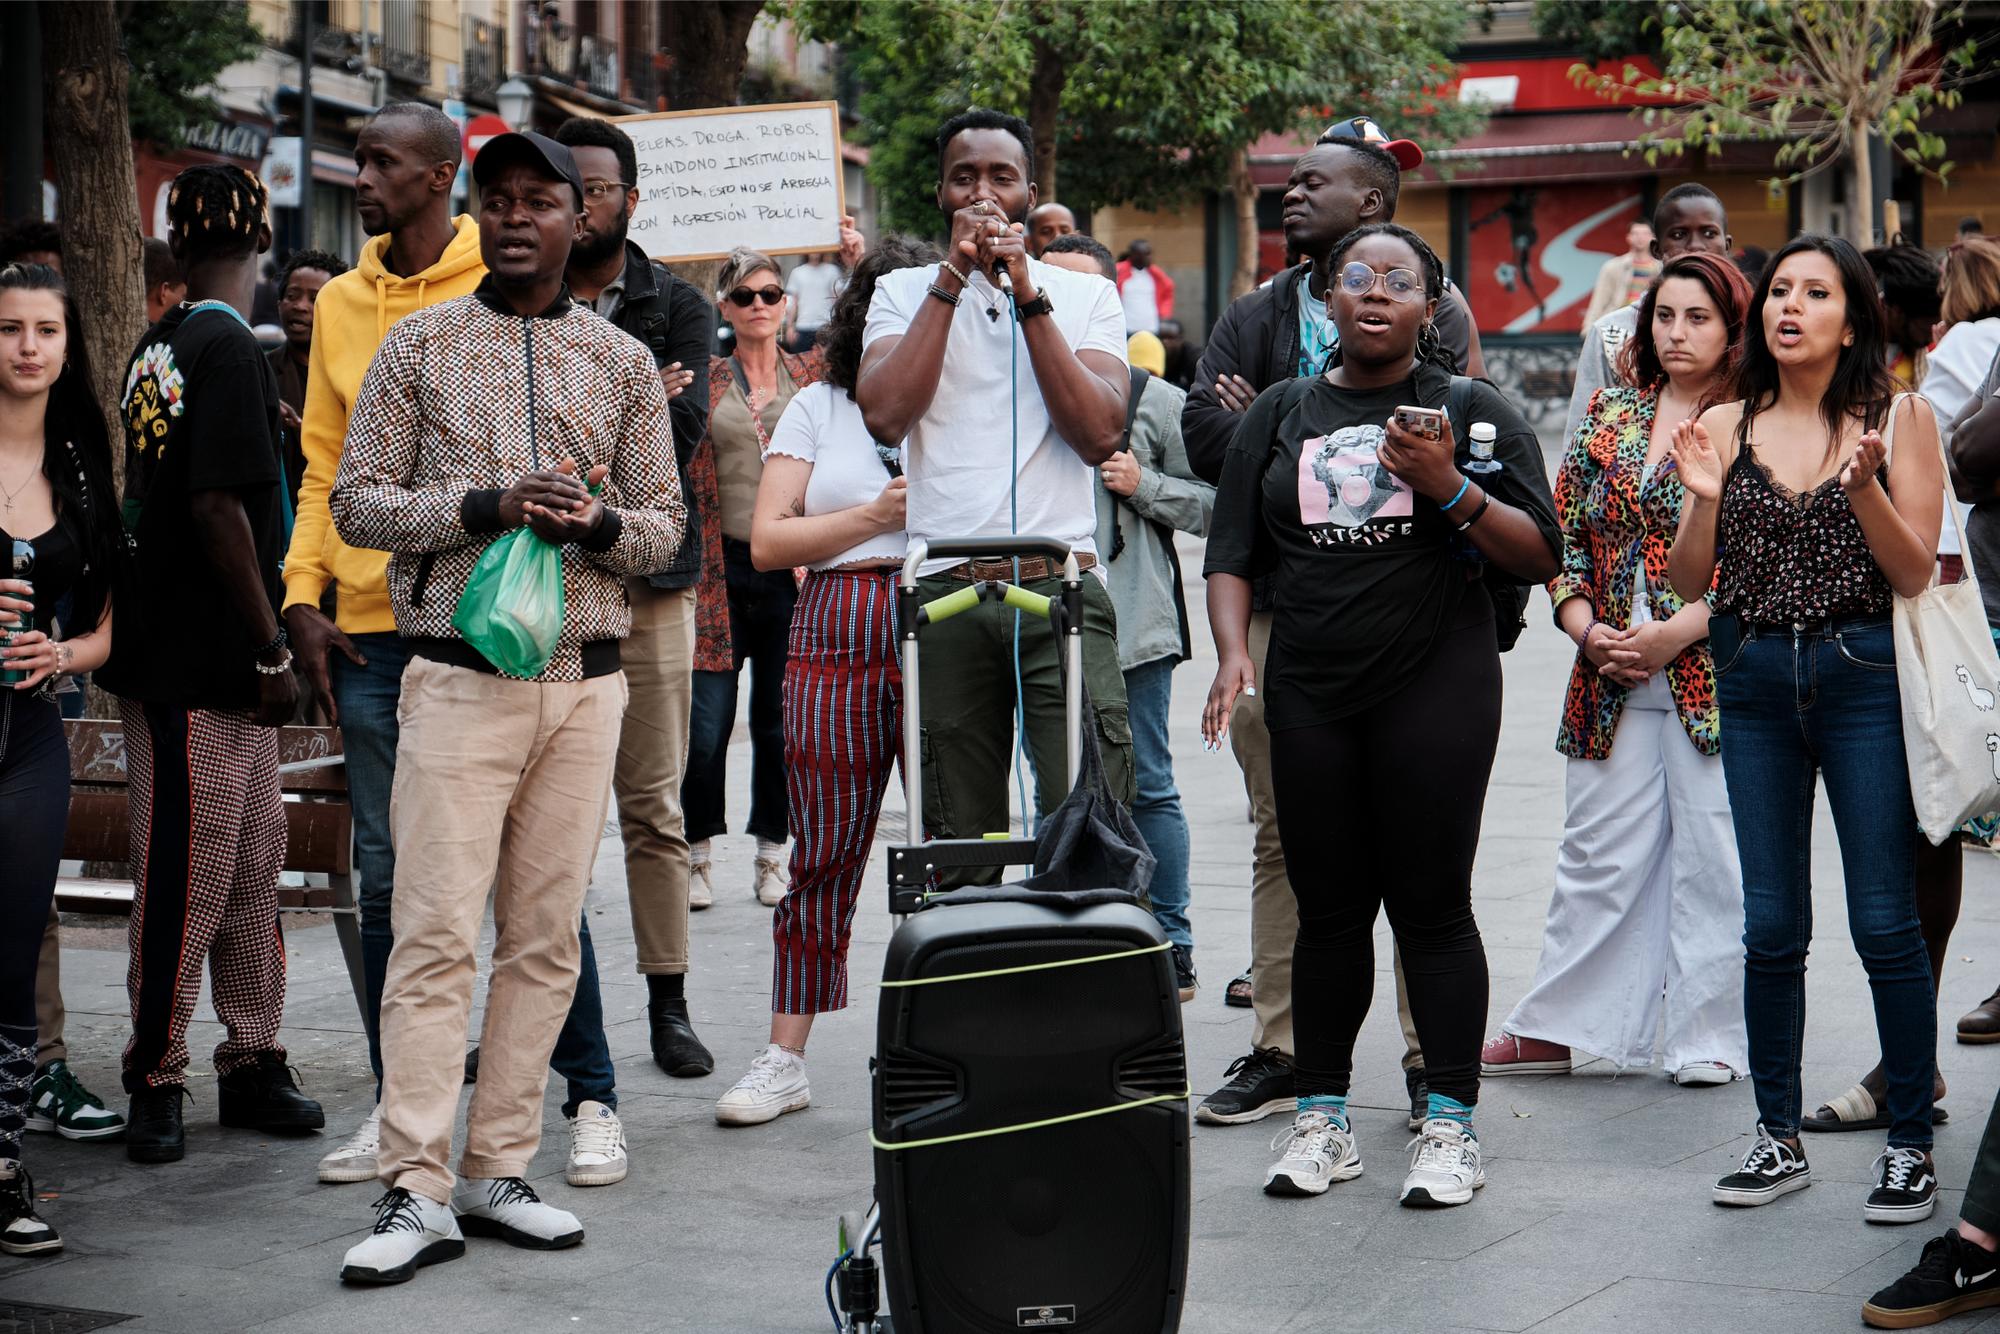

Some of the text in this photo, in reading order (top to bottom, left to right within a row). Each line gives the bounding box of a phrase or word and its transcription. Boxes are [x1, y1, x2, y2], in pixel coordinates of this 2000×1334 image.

[692, 130, 750, 145] DROGA.
[756, 122, 819, 138] ROBOS.
[638, 158, 717, 179] BANDONO
